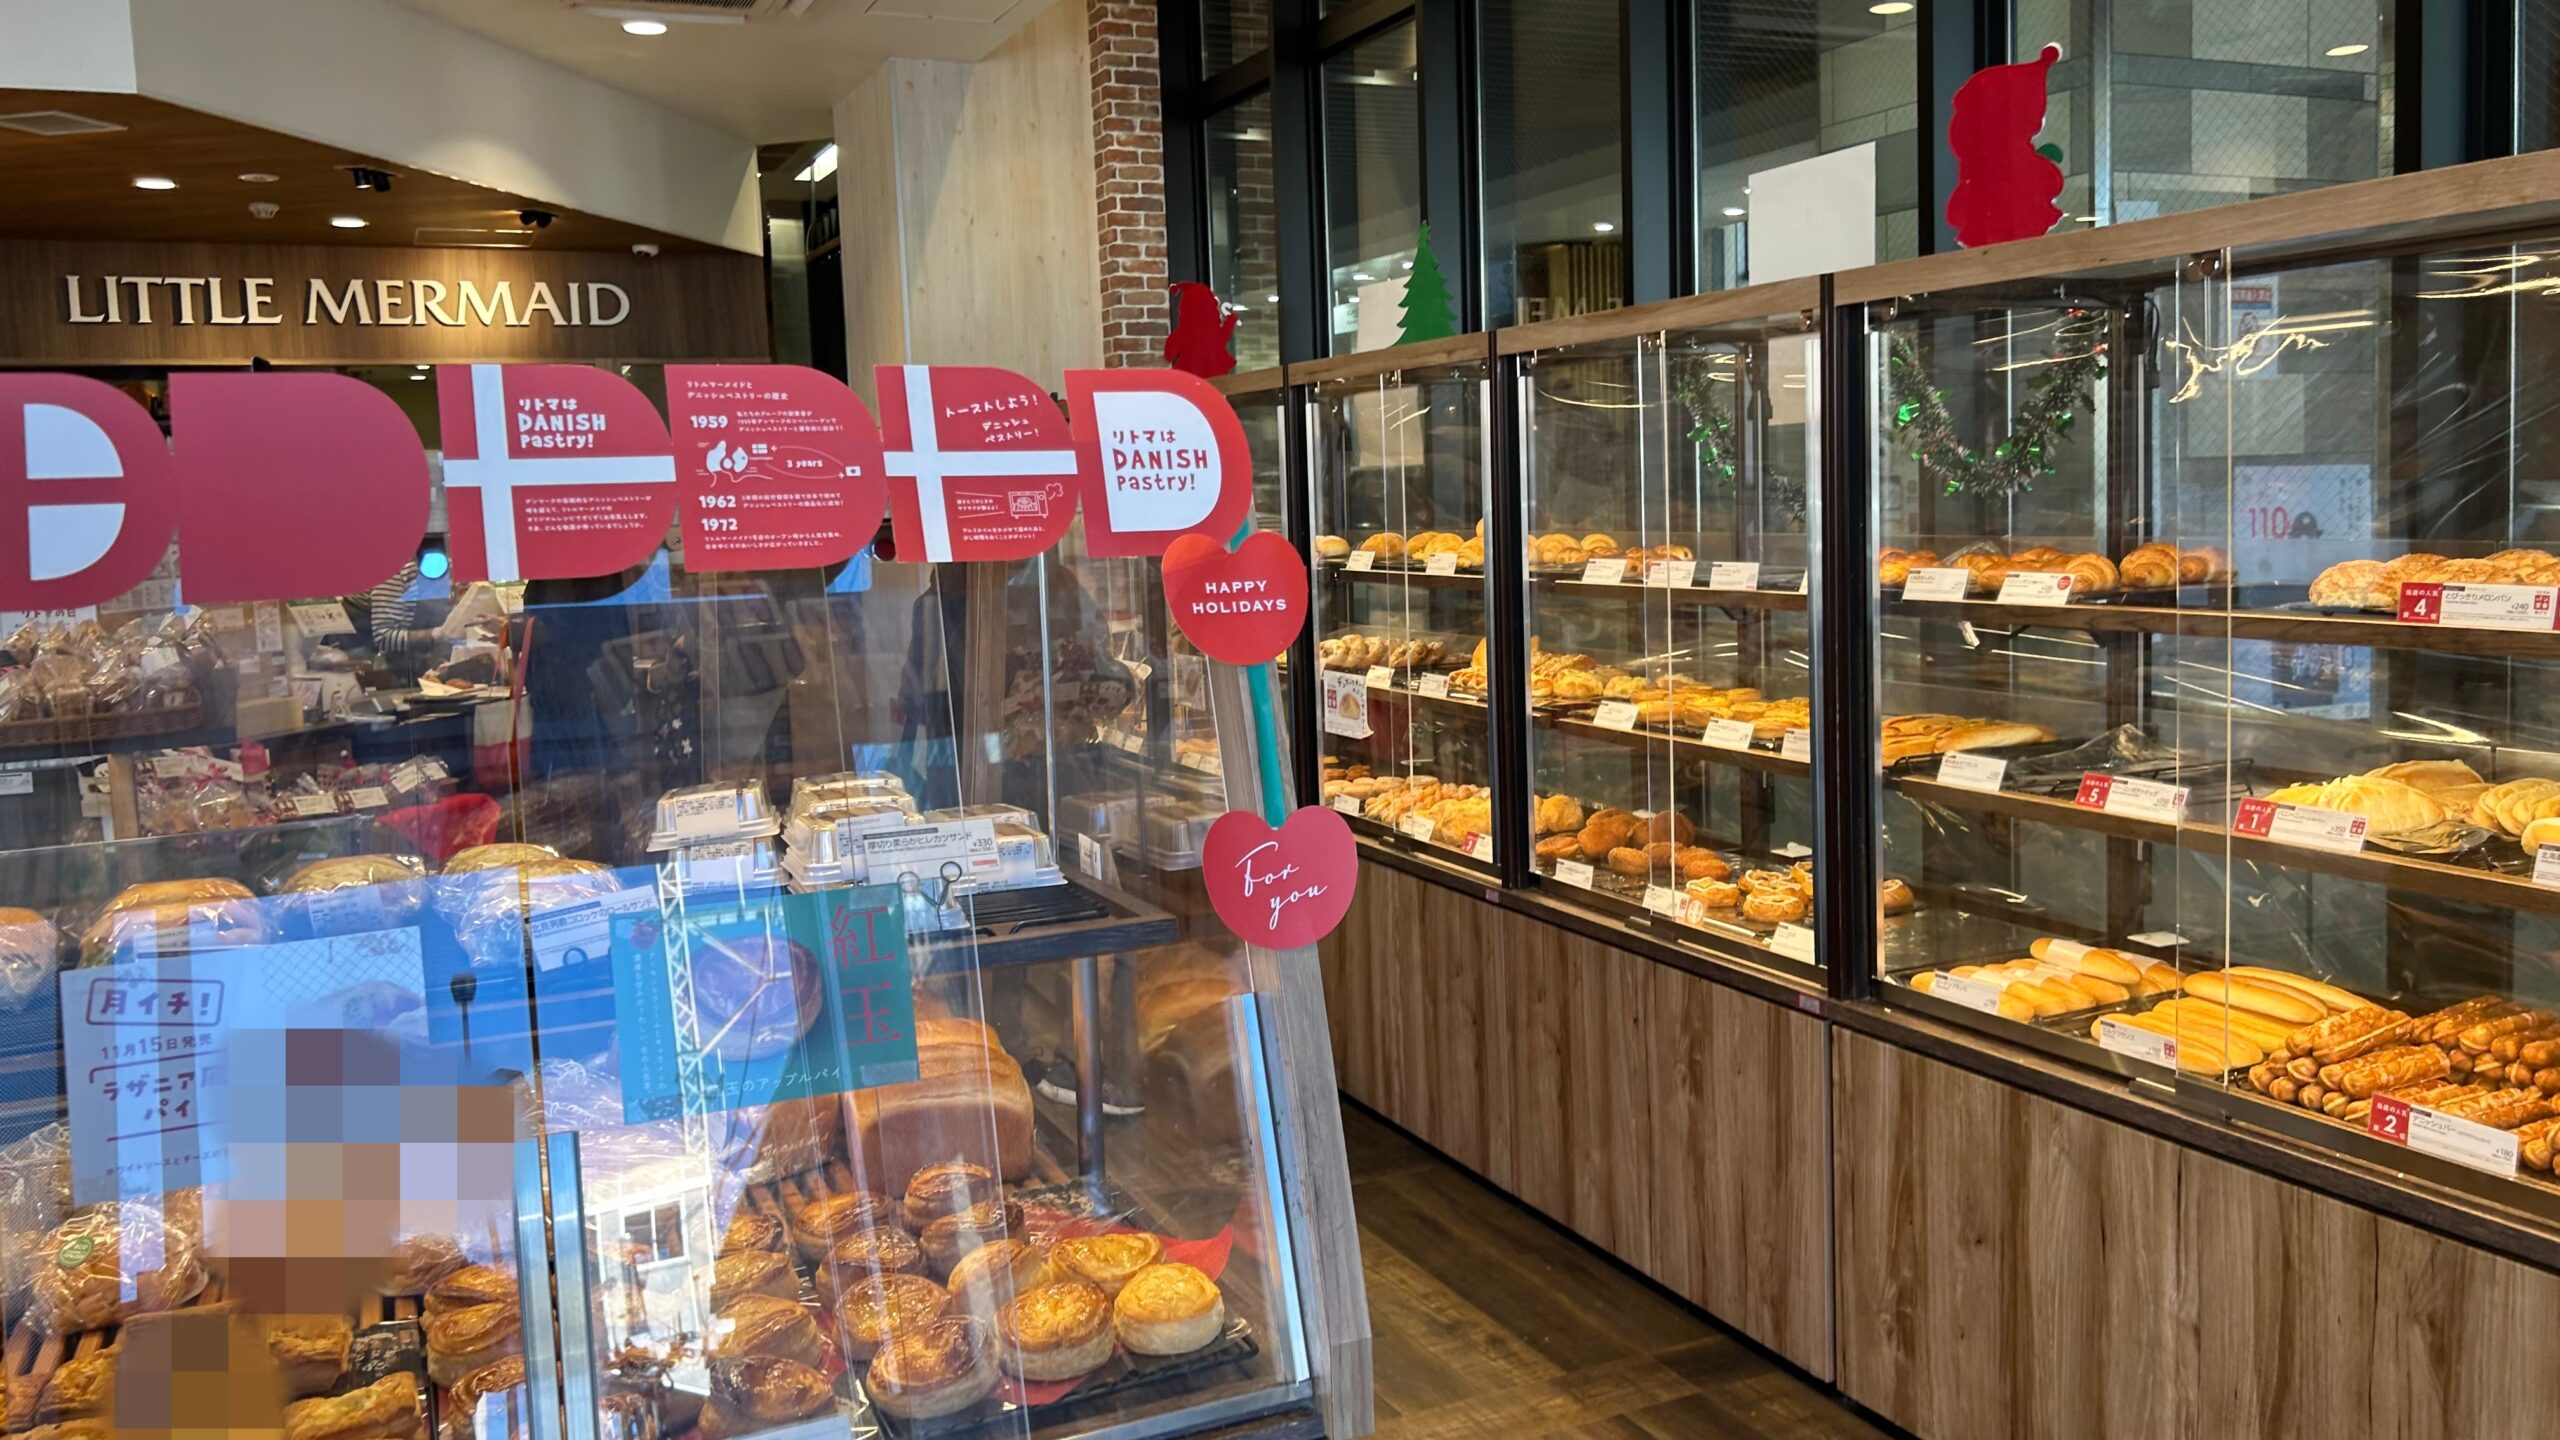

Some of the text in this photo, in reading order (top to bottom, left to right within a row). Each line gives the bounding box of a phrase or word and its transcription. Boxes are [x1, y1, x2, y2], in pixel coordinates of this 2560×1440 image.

[65, 274, 631, 327] LITTLE MERMAID
[518, 398, 578, 411] リトマは
[517, 412, 607, 433] DANISH
[690, 415, 728, 429] 1959
[981, 418, 1030, 432] デニッシュ
[1112, 429, 1176, 444] リトマは
[786, 459, 823, 468] 3 years
[1112, 447, 1208, 472] DANISH
[699, 495, 737, 508] 1962
[701, 518, 738, 531] 1972
[1205, 580, 1267, 595] HAPPY
[1192, 599, 1287, 615] HOLIDAYS
[2413, 598, 2427, 616] 4
[2088, 787, 2100, 802] 5
[2250, 812, 2260, 829] 1
[1268, 884, 1328, 931] you
[828, 904, 905, 1050] 紅玉
[101, 988, 211, 1016] 月イチ!
[101, 1031, 214, 1060] 11月15日発売
[144, 1098, 191, 1121] パイ
[2383, 1114, 2398, 1134] 2
